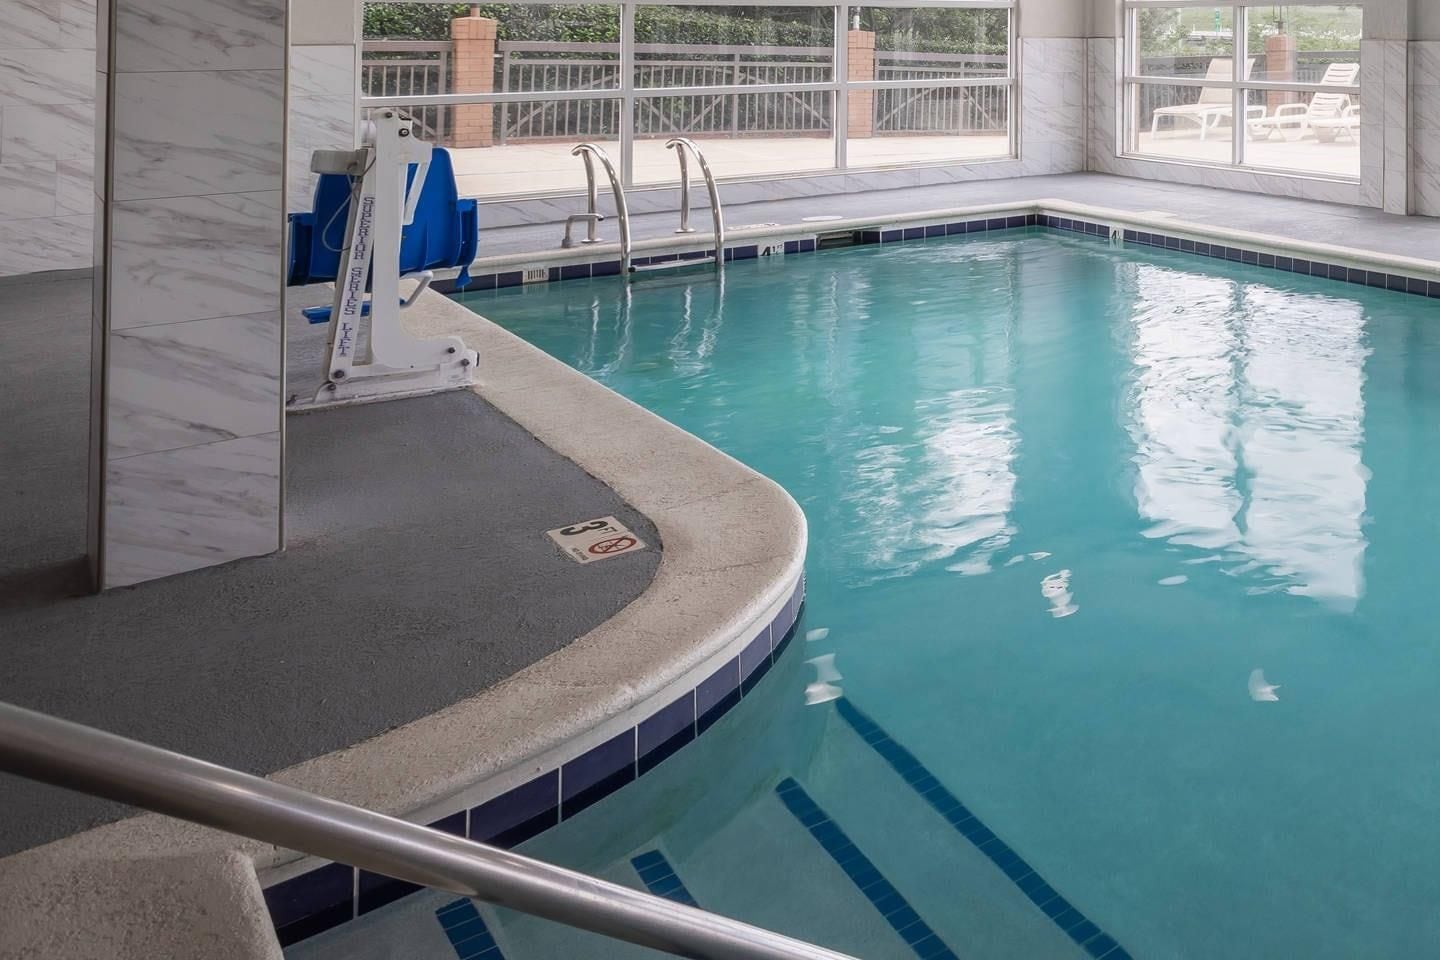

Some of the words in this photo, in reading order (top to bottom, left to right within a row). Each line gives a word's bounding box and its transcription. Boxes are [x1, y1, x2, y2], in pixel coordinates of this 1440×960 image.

[353, 196, 376, 260] SUPERIOR
[344, 266, 363, 316] SERIES
[338, 322, 352, 357] LIFT
[560, 521, 608, 535] 3
